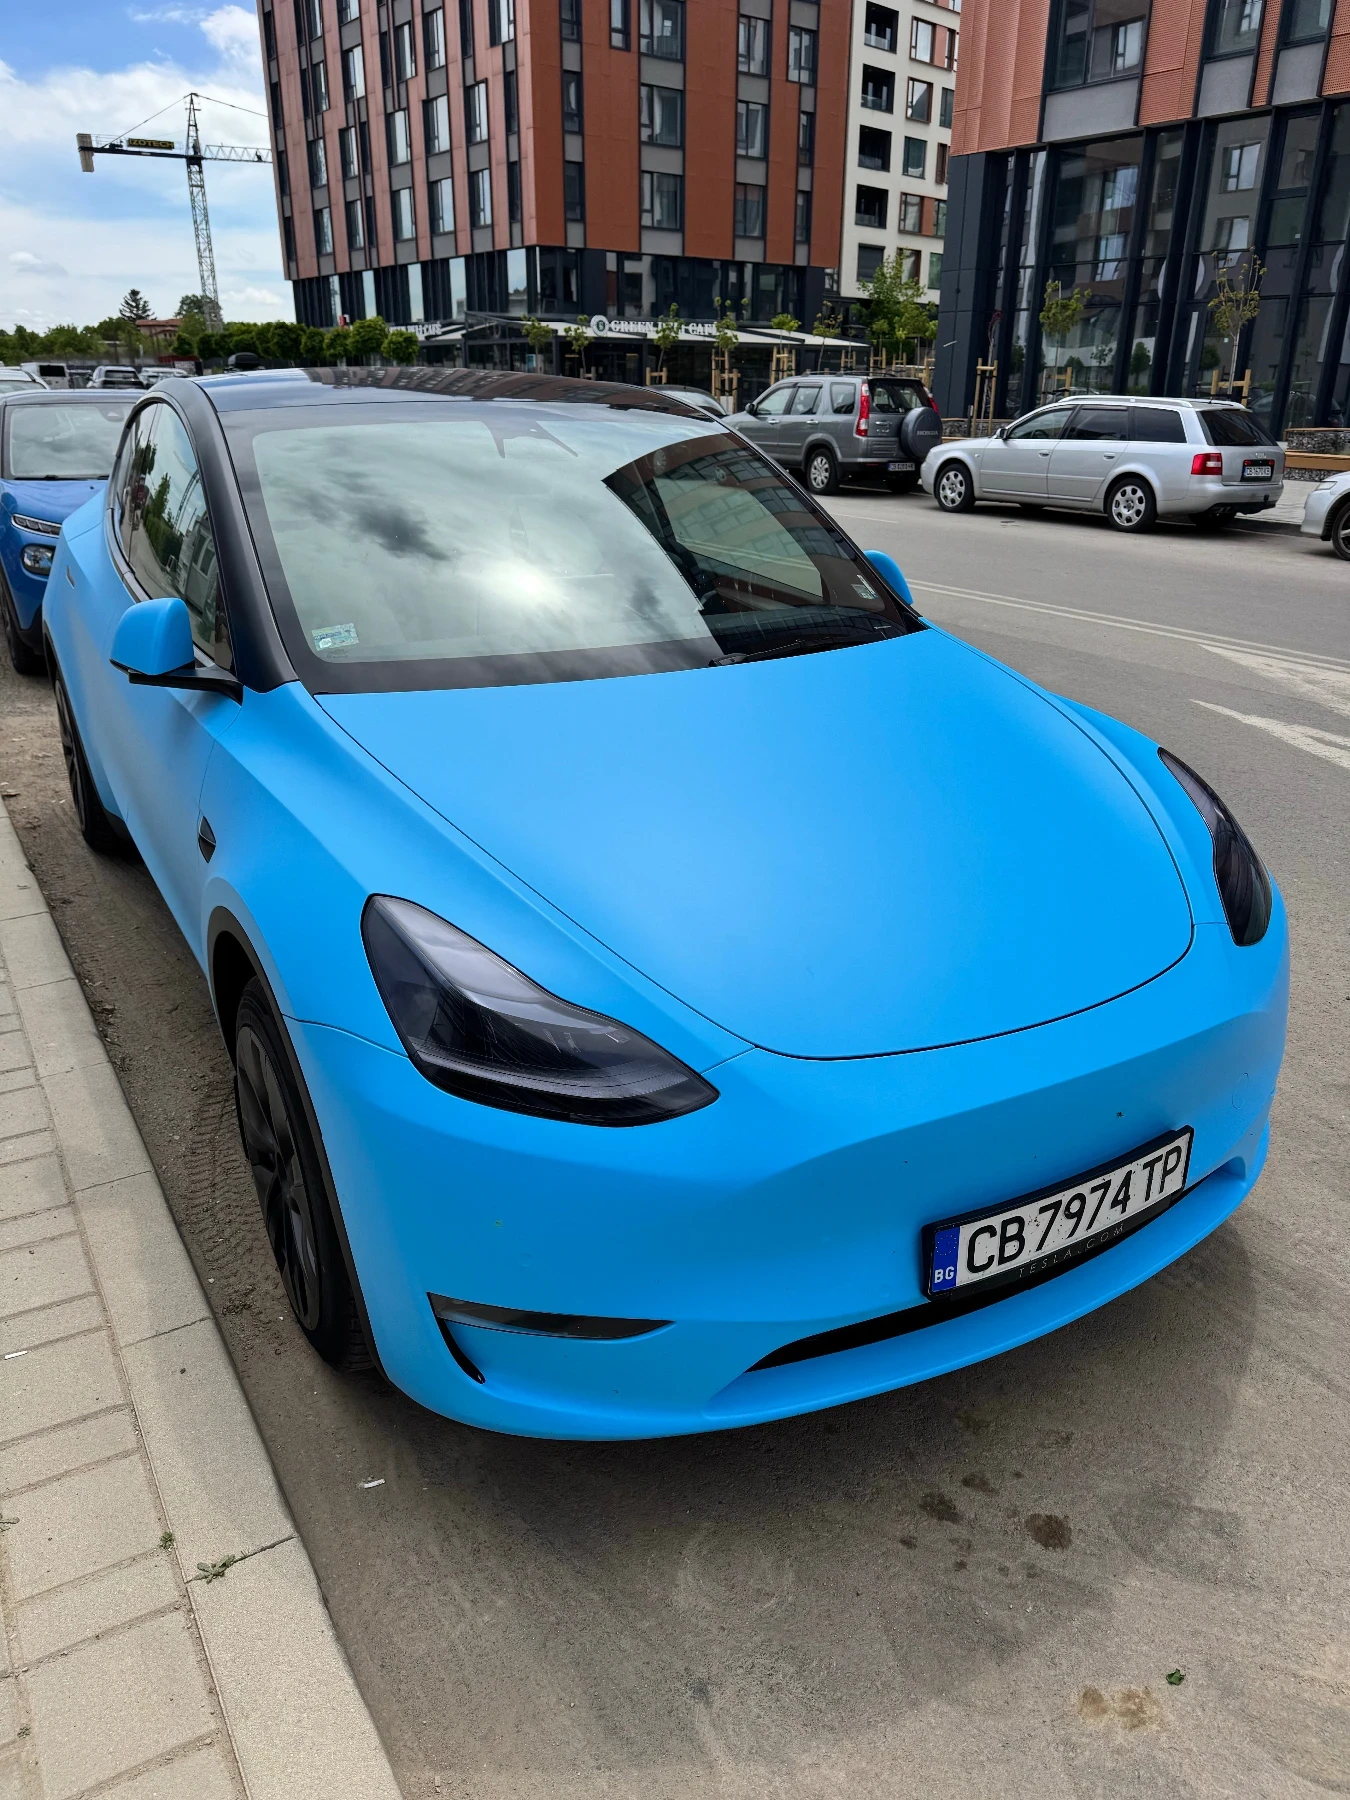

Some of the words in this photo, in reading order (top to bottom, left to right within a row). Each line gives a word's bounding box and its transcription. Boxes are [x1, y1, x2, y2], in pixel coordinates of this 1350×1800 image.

[129, 139, 174, 148] IZOTECH
[610, 320, 654, 333] GREEN
[966, 1215, 1026, 1274] CB
[1035, 1170, 1133, 1252] 7974
[1142, 1145, 1183, 1202] TP
[1018, 1224, 1124, 1278] TESLA.COM
[934, 1266, 955, 1284] BG
